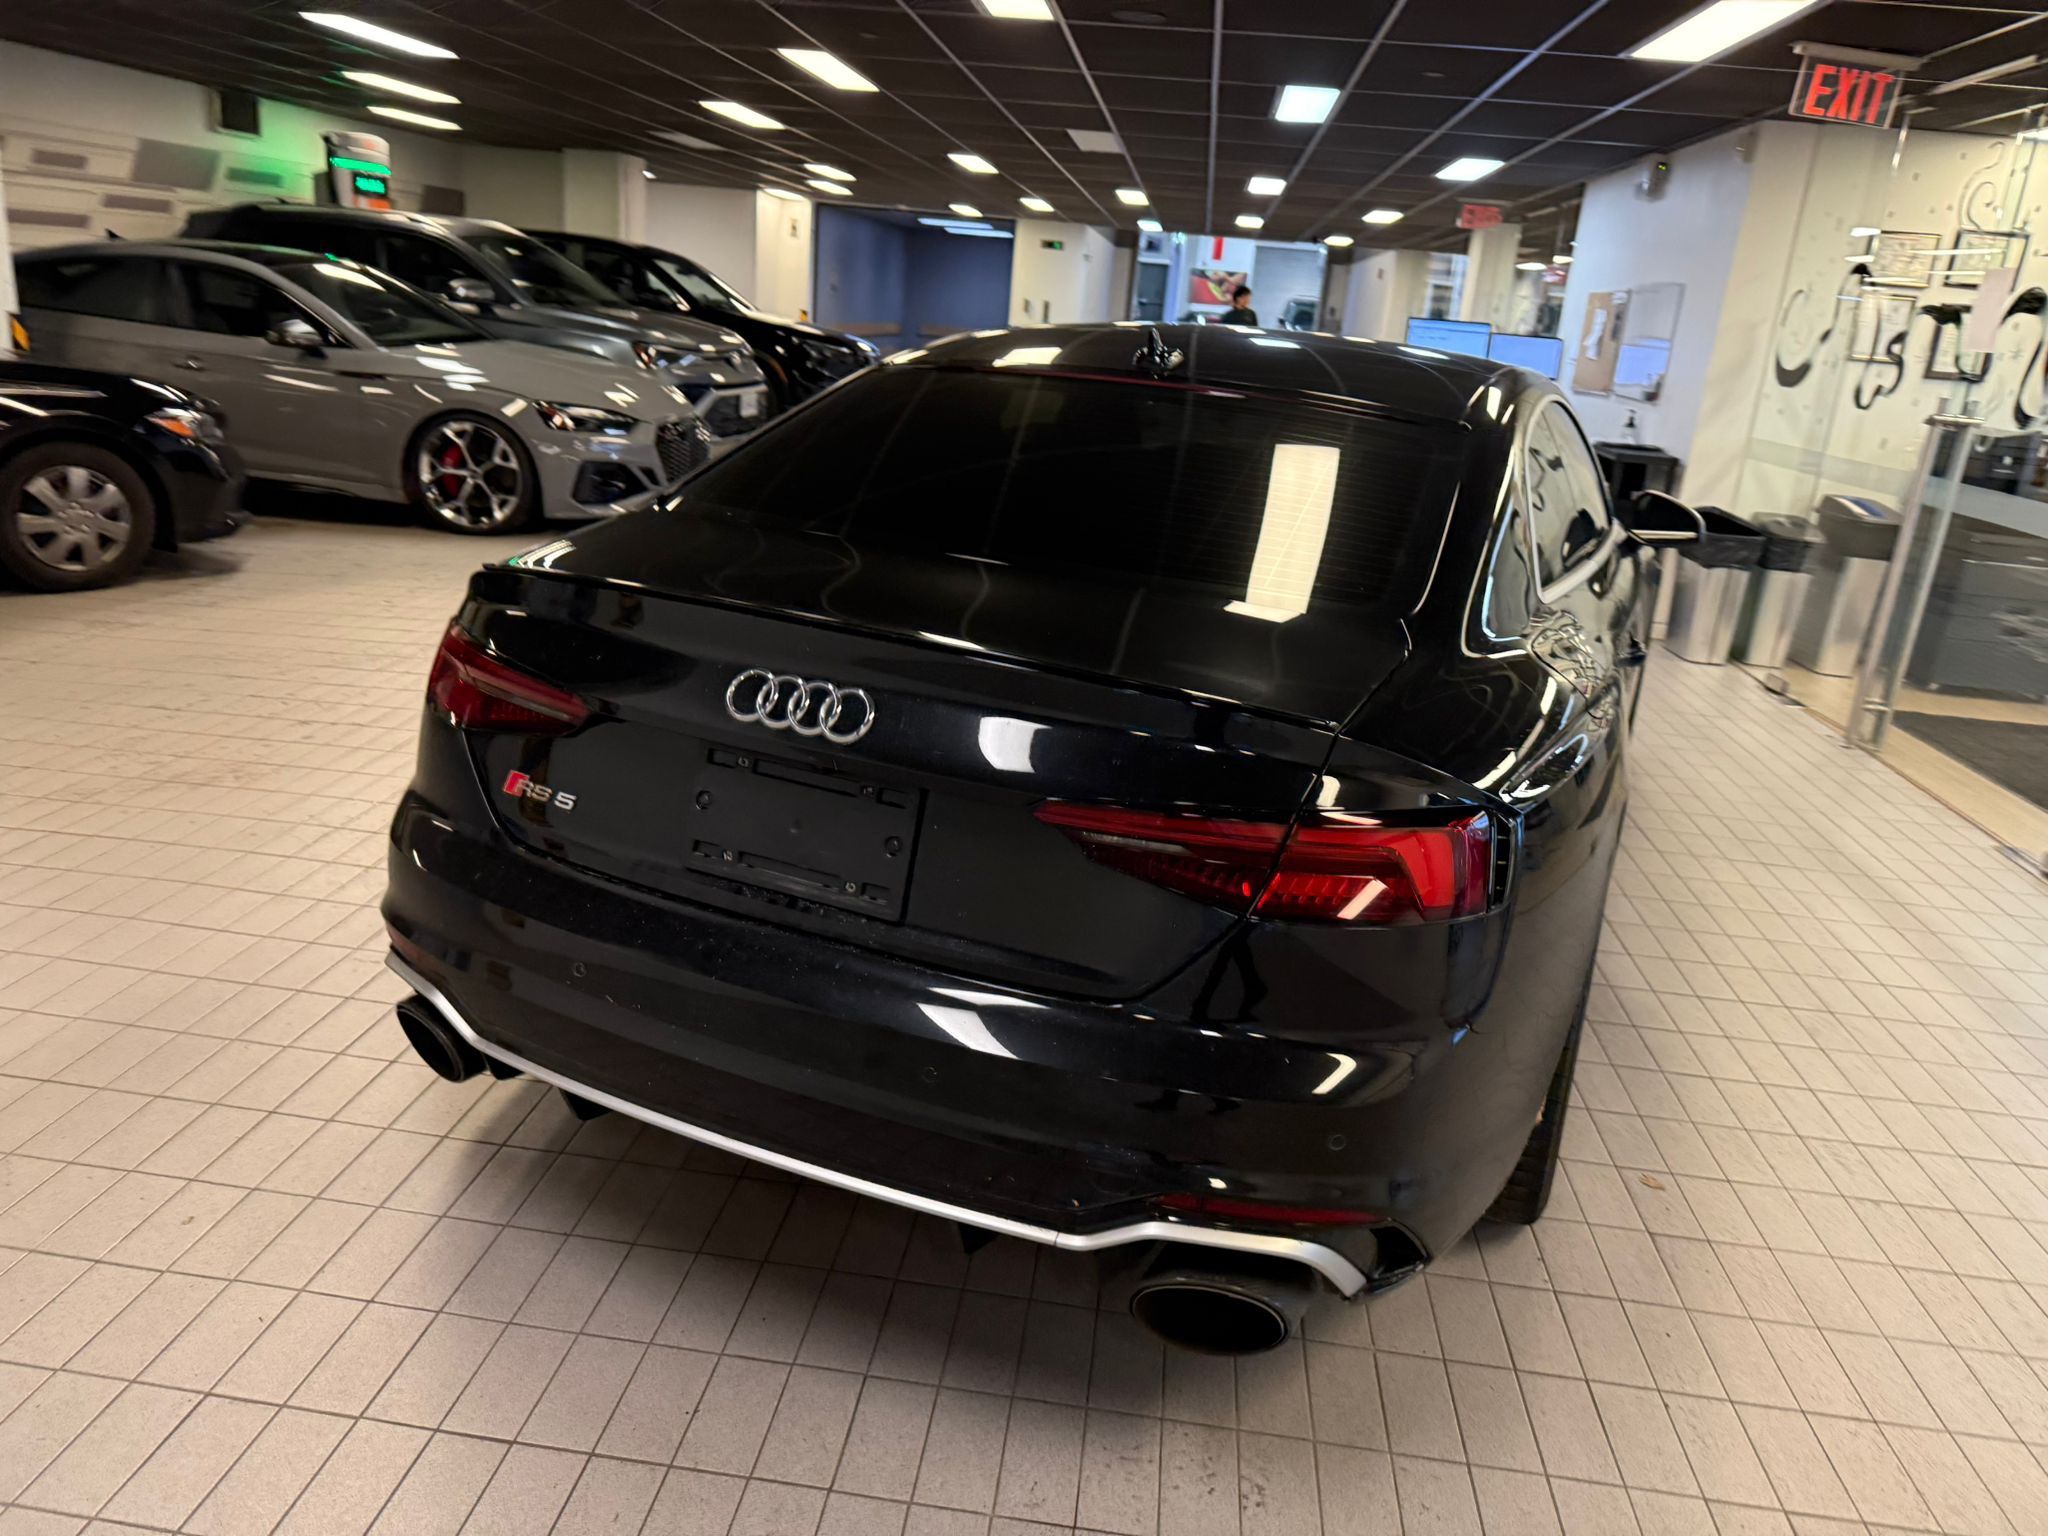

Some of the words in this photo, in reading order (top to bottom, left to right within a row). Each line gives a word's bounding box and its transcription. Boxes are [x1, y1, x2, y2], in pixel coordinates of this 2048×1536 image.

[1803, 64, 1895, 124] EXIT
[509, 775, 553, 802] RS
[554, 791, 577, 811] 5
